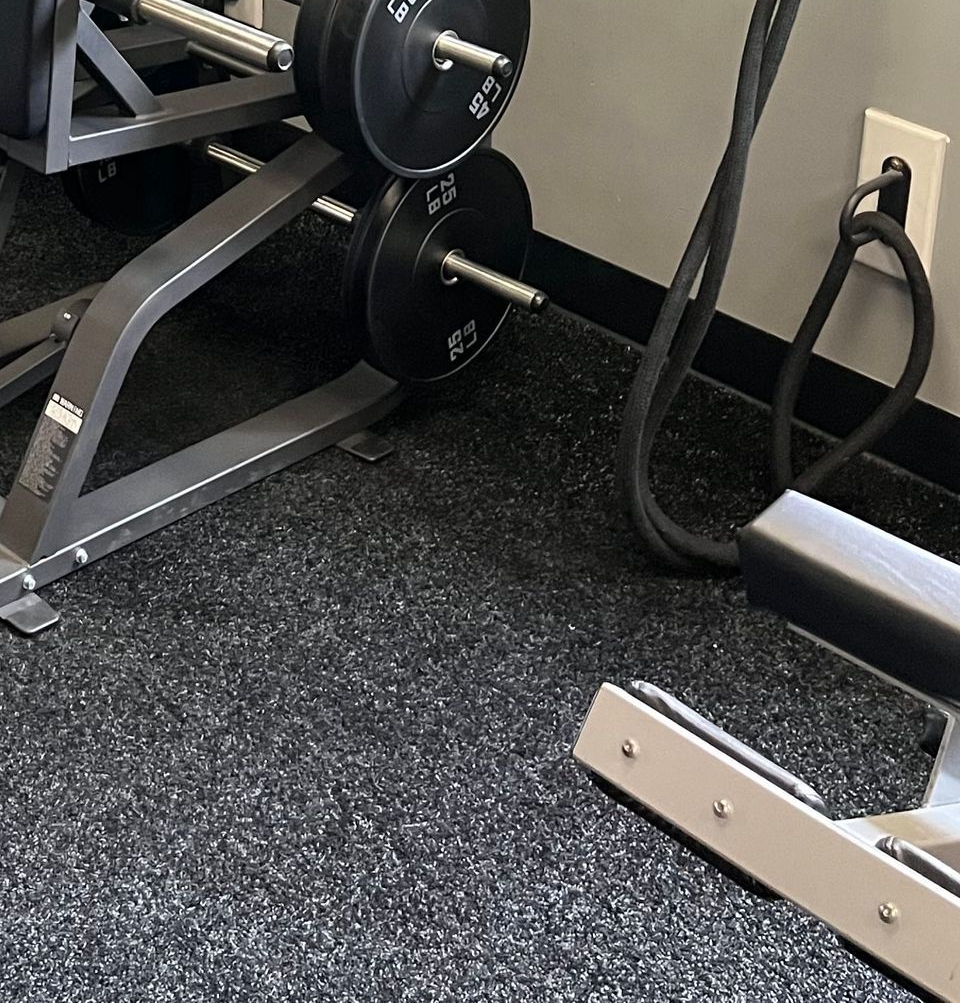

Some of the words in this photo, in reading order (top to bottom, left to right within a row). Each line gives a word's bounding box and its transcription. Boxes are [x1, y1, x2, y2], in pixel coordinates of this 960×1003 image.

[482, 76, 502, 103] LB
[469, 92, 490, 120] 45
[98, 162, 117, 183] LB
[426, 185, 441, 215] LB
[440, 172, 457, 206] 25
[448, 329, 464, 361] 25
[463, 319, 478, 348] LB
